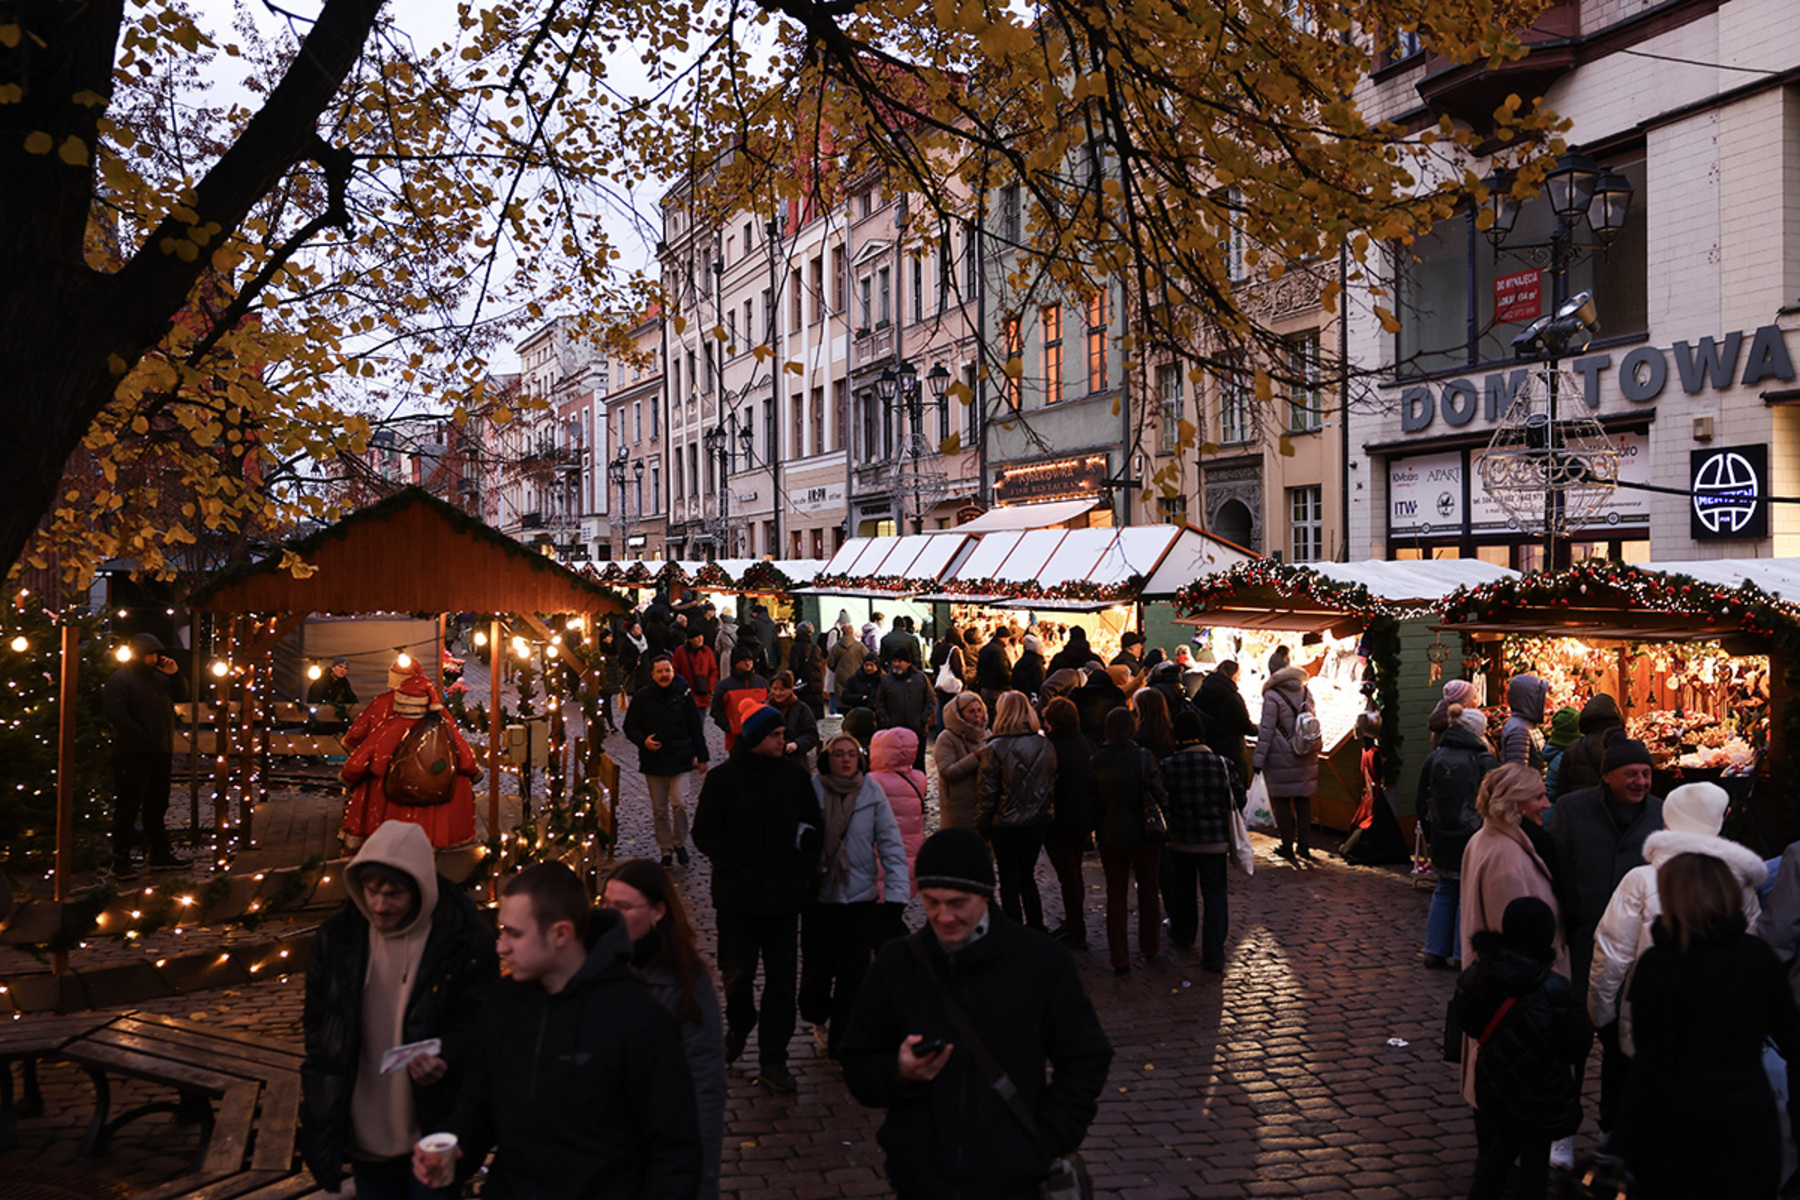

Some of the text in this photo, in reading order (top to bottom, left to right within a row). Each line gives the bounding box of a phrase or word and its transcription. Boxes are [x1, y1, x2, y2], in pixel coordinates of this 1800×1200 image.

[1401, 324, 1796, 432] DOM TOWA
[1426, 466, 1461, 483] APART
